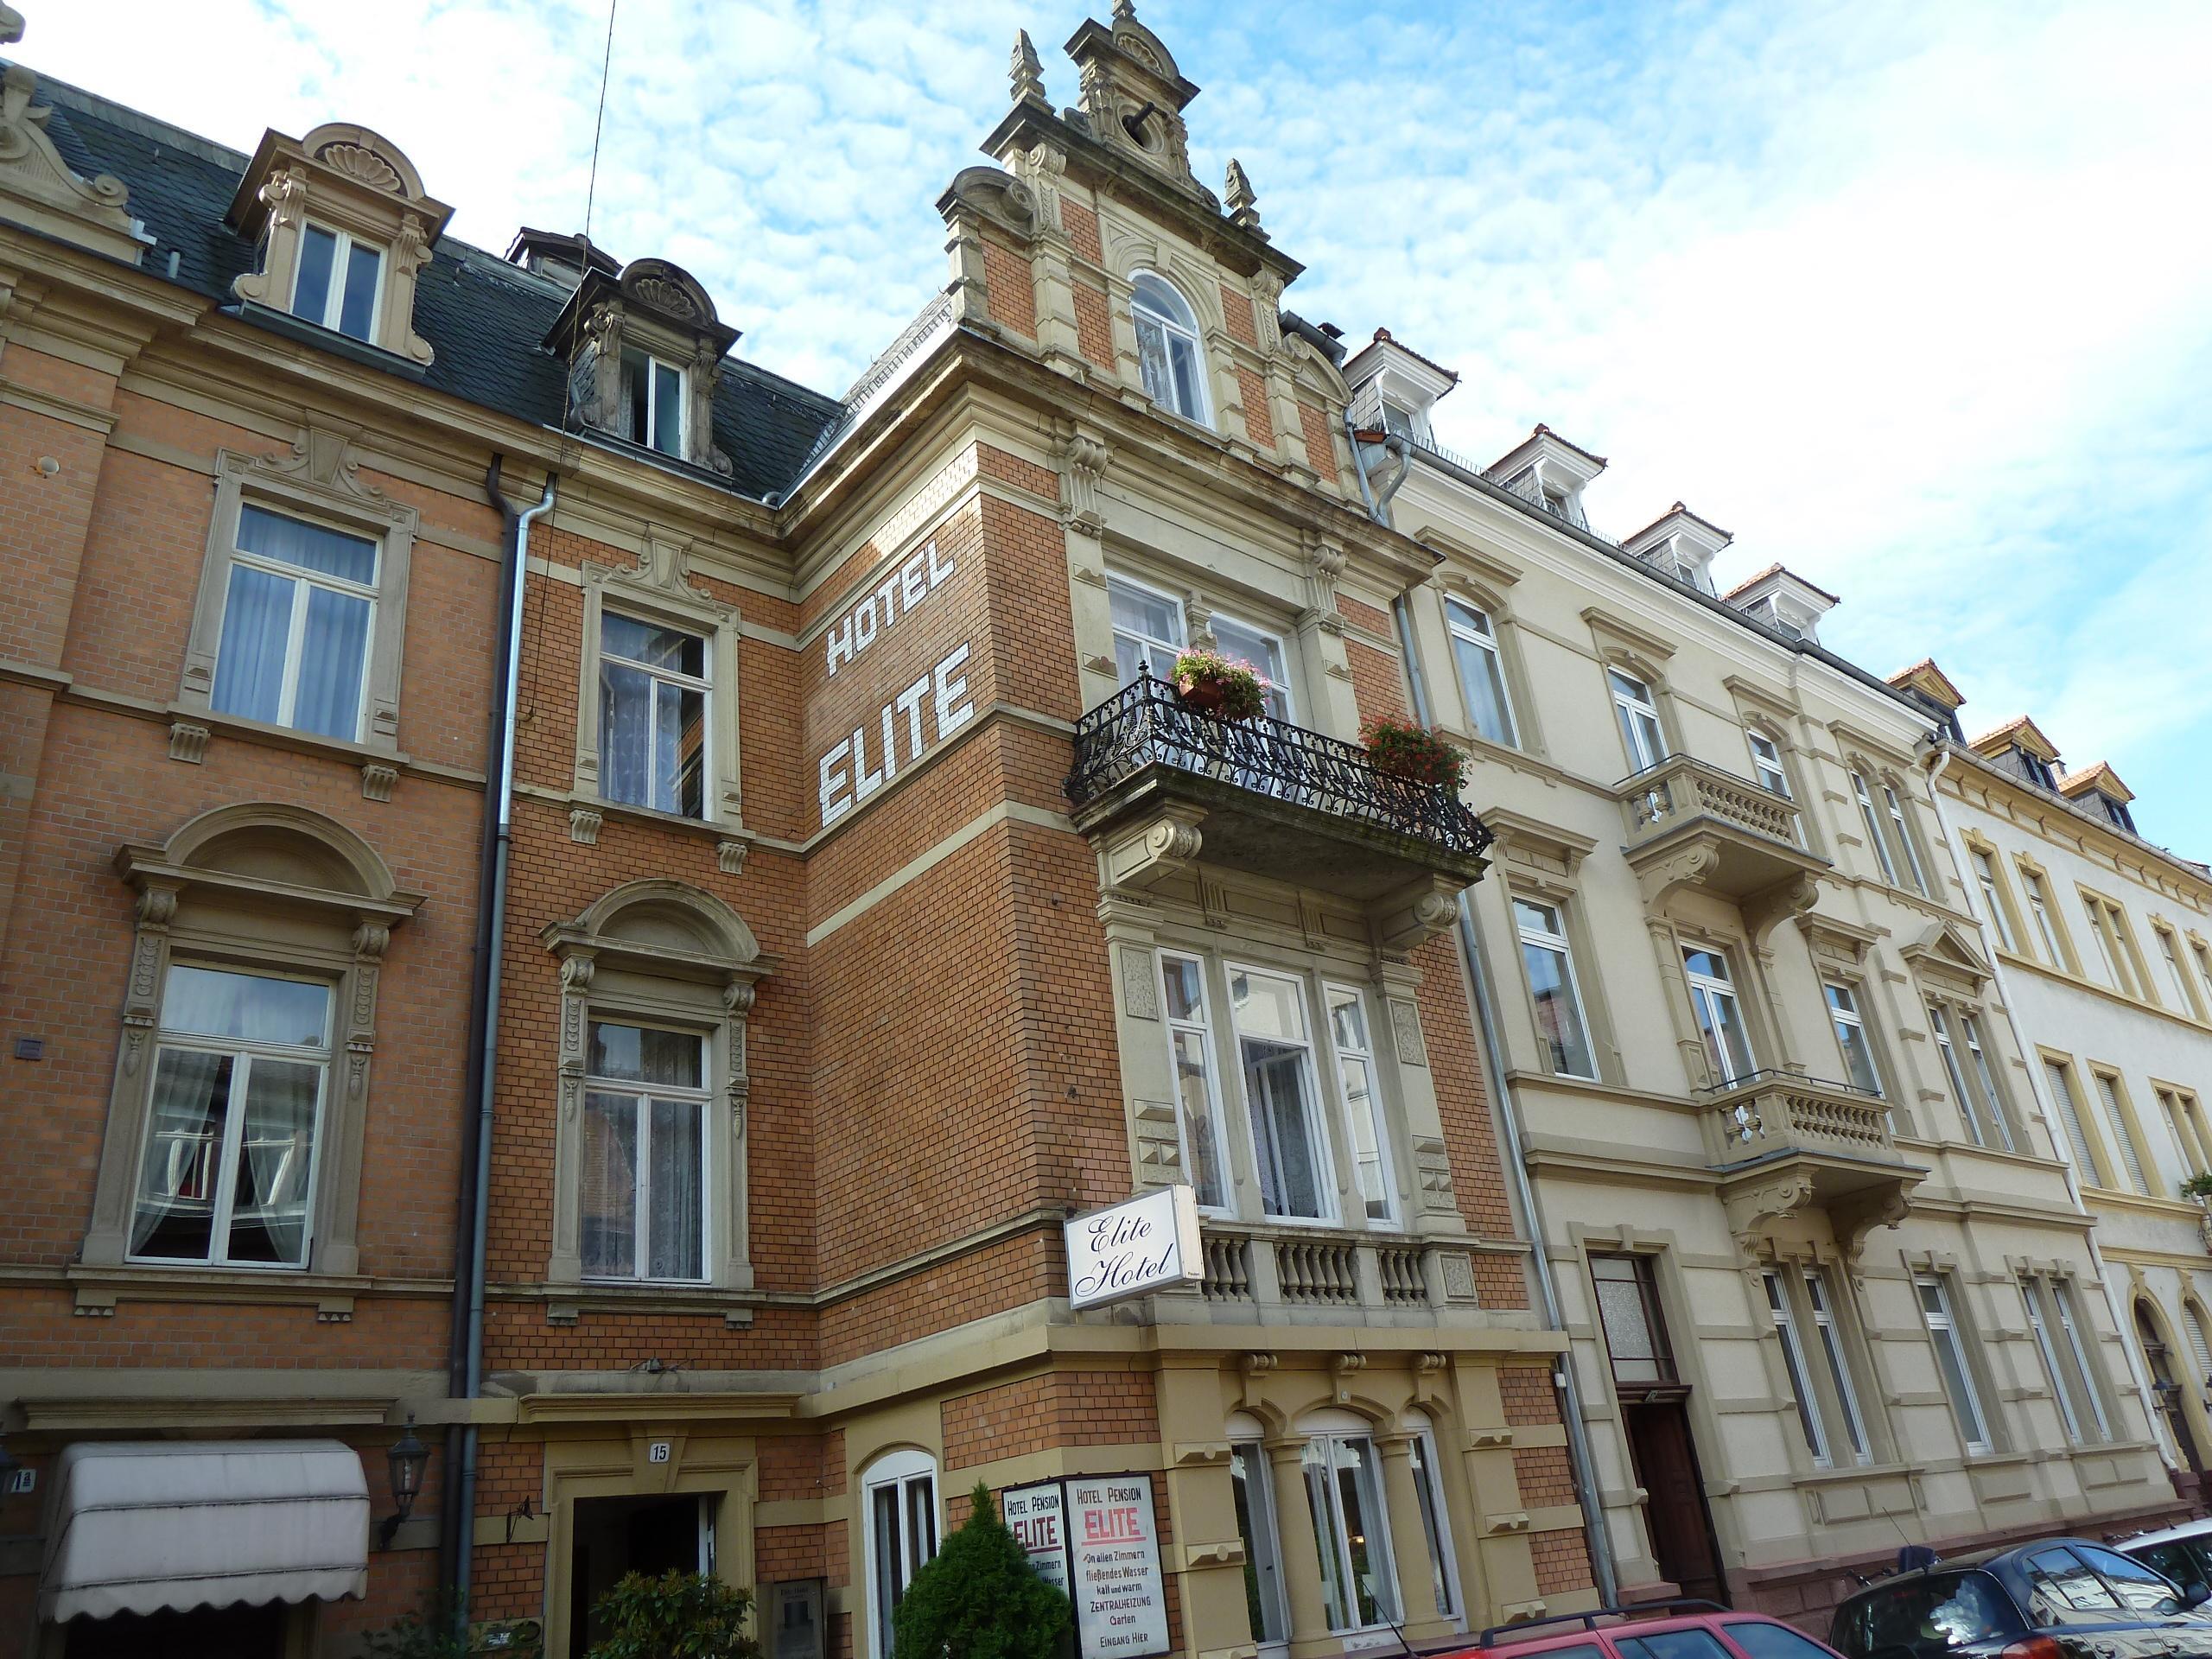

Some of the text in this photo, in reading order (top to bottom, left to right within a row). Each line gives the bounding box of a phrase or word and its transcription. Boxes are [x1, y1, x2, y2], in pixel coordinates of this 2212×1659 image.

[826, 539, 956, 678] HOTEL
[818, 641, 975, 829] ELITE
[1088, 1216, 1152, 1255] Elite
[1075, 1243, 1173, 1297] Hotel
[653, 1446, 666, 1460] 15
[1007, 1494, 1059, 1516] HOTEL PENSION
[1077, 1486, 1141, 1504] HOTEL PENSION
[1014, 1516, 1058, 1548] ELITE
[1084, 1507, 1141, 1540] ELITE
[1036, 1560, 1062, 1571] Zimmern
[1096, 1553, 1113, 1563] allen
[1114, 1551, 1145, 1561] Zimmern
[1122, 1566, 1149, 1579] Wasser
[1096, 1583, 1142, 1595] kalt und warm
[1109, 1614, 1136, 1625] Garten
